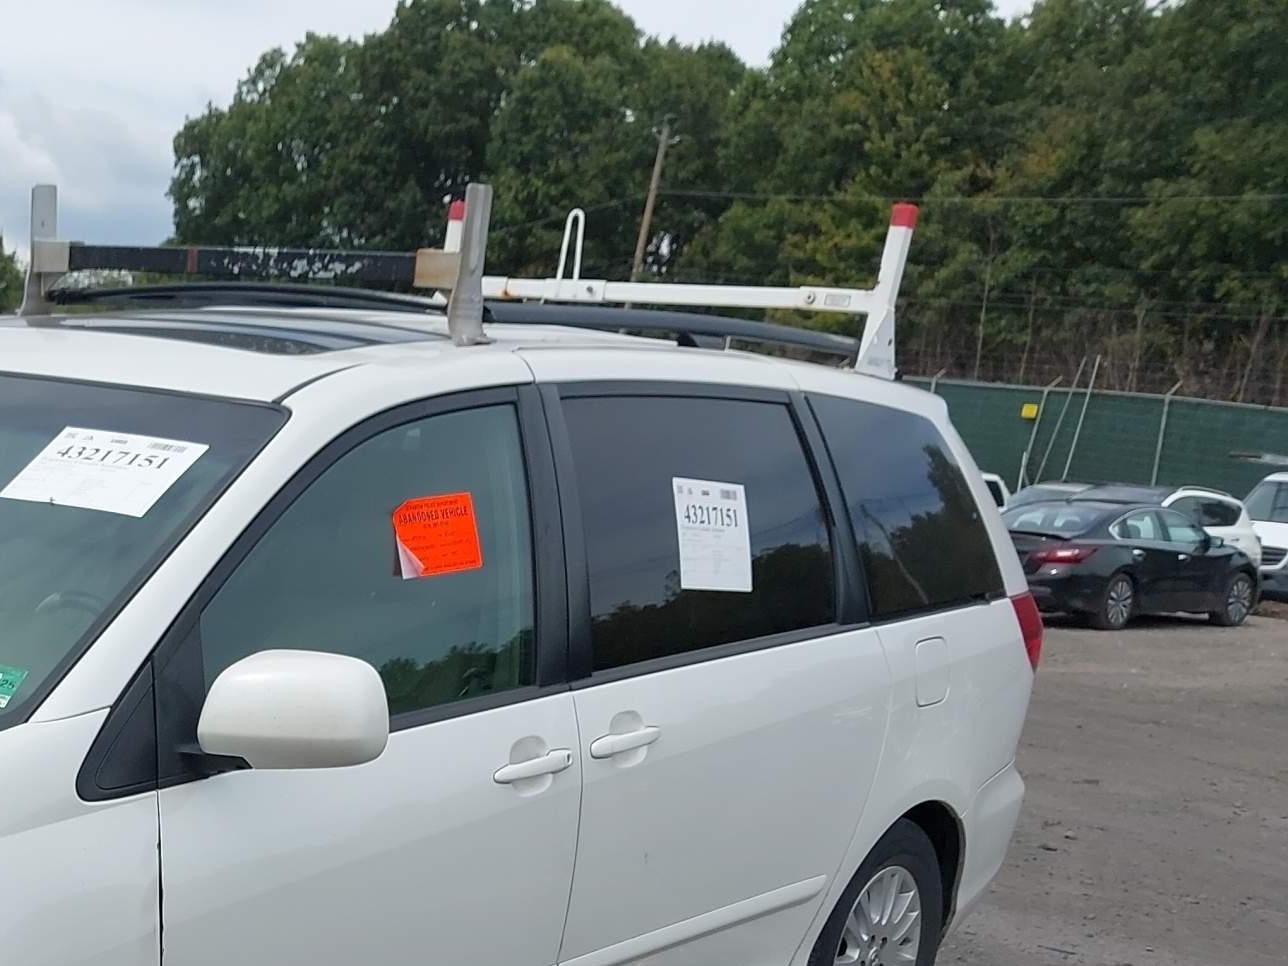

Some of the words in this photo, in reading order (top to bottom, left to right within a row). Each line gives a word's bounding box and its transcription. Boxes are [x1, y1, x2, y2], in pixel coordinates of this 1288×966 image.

[57, 444, 170, 470] 43217151
[440, 505, 468, 520] VEHICLE
[684, 504, 738, 528] 43217151
